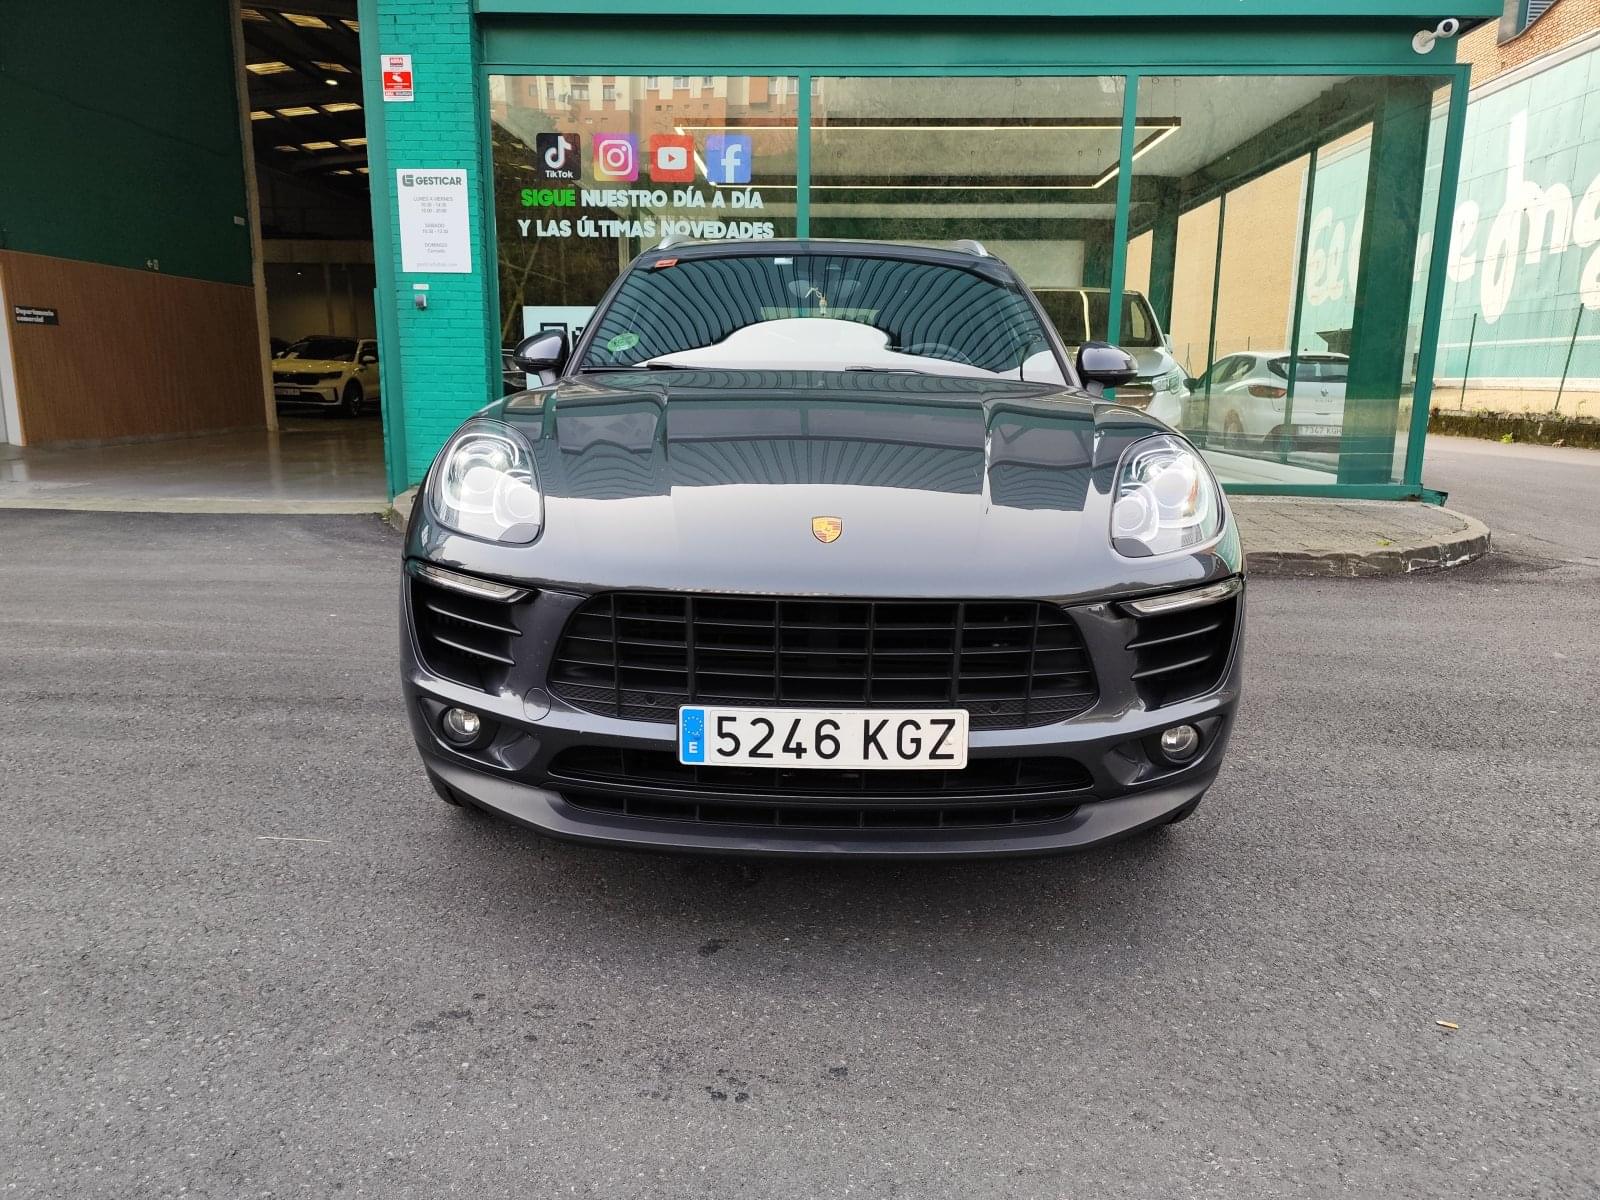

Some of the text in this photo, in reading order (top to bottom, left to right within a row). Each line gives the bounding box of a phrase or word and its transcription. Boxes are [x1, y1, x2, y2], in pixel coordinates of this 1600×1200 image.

[415, 176, 462, 186] GESTICAR
[545, 169, 573, 178] TikTok
[521, 186, 764, 209] SIGUE NUESTRO DÍA A DÍA
[517, 216, 775, 239] Y LAS ÚLTIMAS NOVEDADES
[688, 715, 956, 761] E 5246 KGZ
